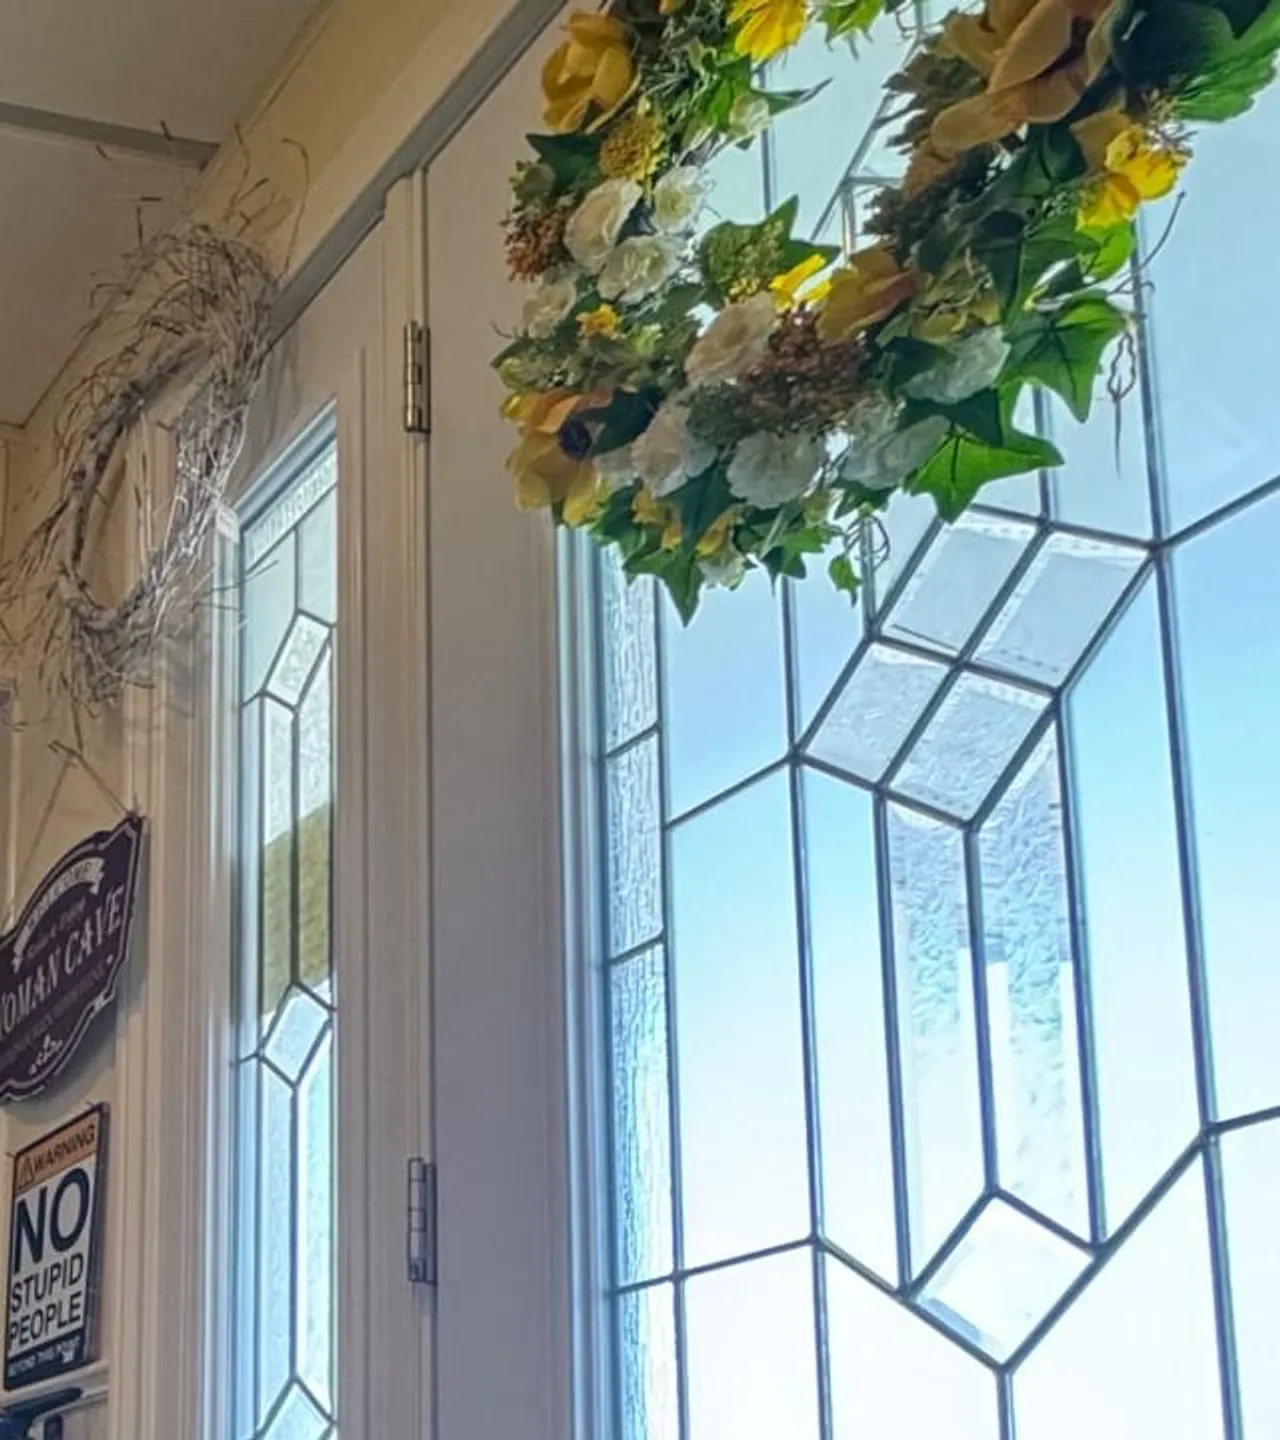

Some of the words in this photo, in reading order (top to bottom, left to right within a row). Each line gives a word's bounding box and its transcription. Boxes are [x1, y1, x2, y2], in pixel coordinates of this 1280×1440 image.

[64, 884, 125, 975] CAVE
[33, 1124, 96, 1174] WARNING
[14, 1168, 90, 1274] NO
[12, 1252, 83, 1313] STUPID
[10, 1293, 82, 1347] PEOPLE
